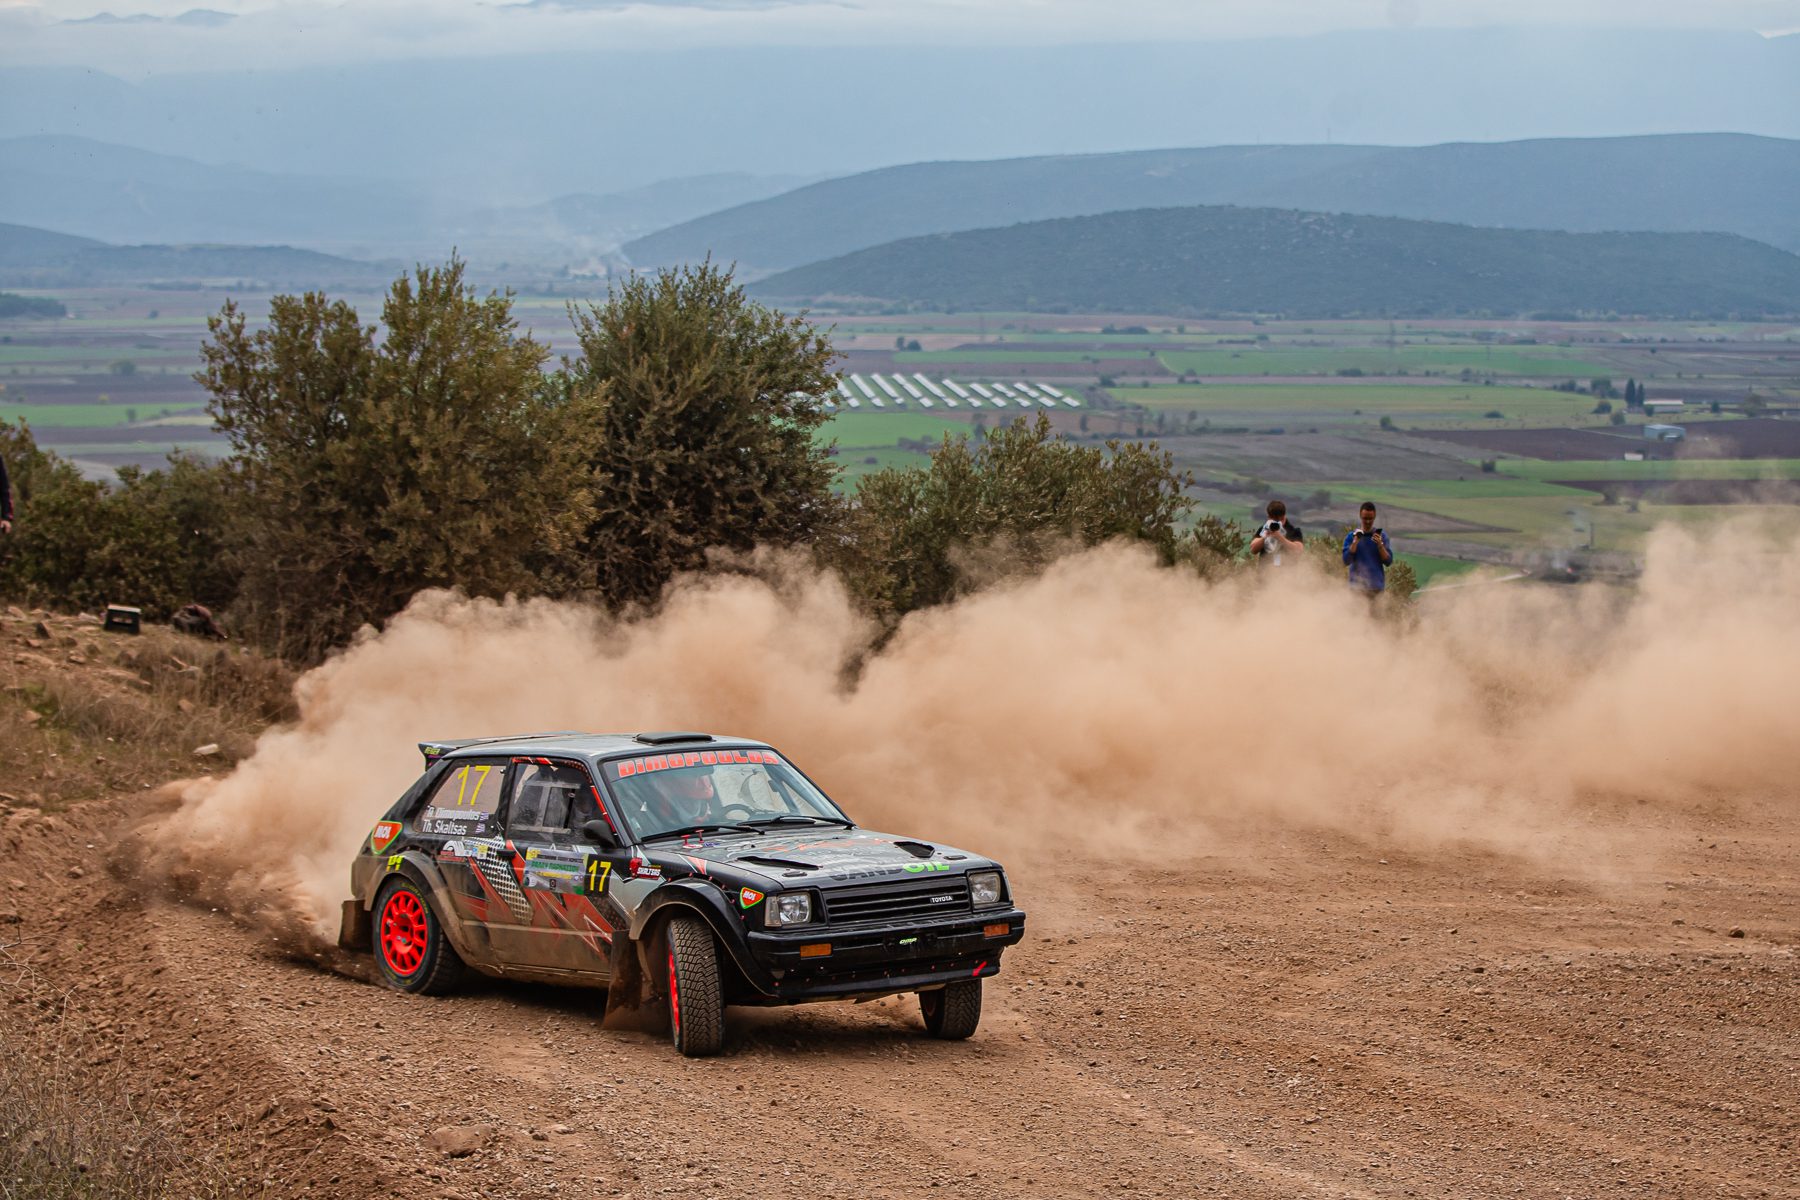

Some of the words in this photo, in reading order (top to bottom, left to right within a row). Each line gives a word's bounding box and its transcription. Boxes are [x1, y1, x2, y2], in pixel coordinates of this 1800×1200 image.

[457, 765, 491, 806] 17
[422, 819, 433, 833] Th.
[434, 820, 468, 836] Skaltsas
[588, 860, 612, 892] 17
[743, 890, 757, 901] MOL
[931, 895, 953, 904] TOYOTA
